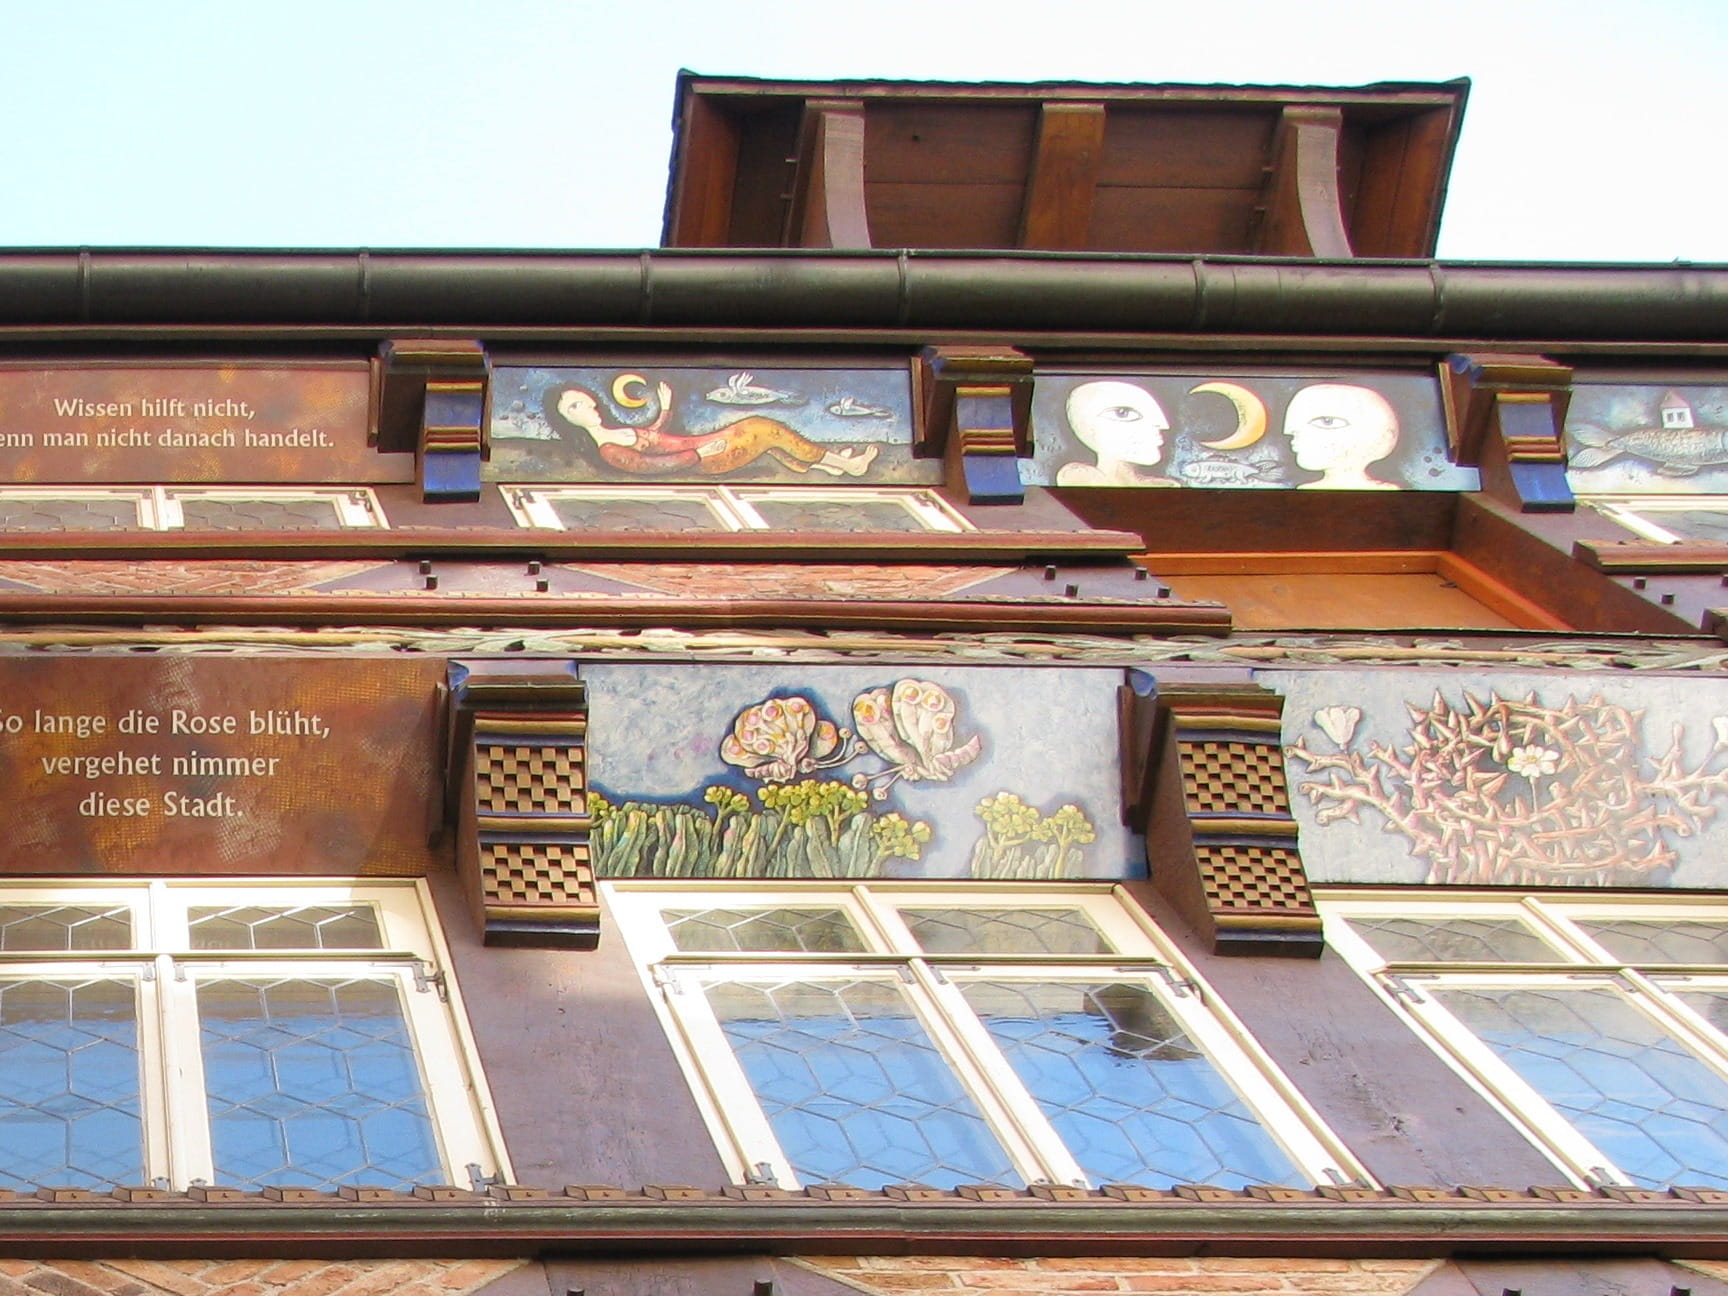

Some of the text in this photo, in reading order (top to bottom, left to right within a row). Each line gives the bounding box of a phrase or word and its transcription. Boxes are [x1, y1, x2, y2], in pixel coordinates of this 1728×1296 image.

[53, 398, 255, 420] Wissen hilft nicht,
[43, 432, 89, 447] man
[97, 428, 152, 447] nicht
[158, 428, 235, 447] danach
[245, 428, 334, 447] handelt.
[35, 709, 106, 738] lange
[118, 709, 160, 734] die
[172, 709, 237, 734] Rose
[249, 710, 330, 739] blüht,
[42, 750, 280, 779] vergehet nimmer
[79, 791, 244, 818] diese Stadt.
